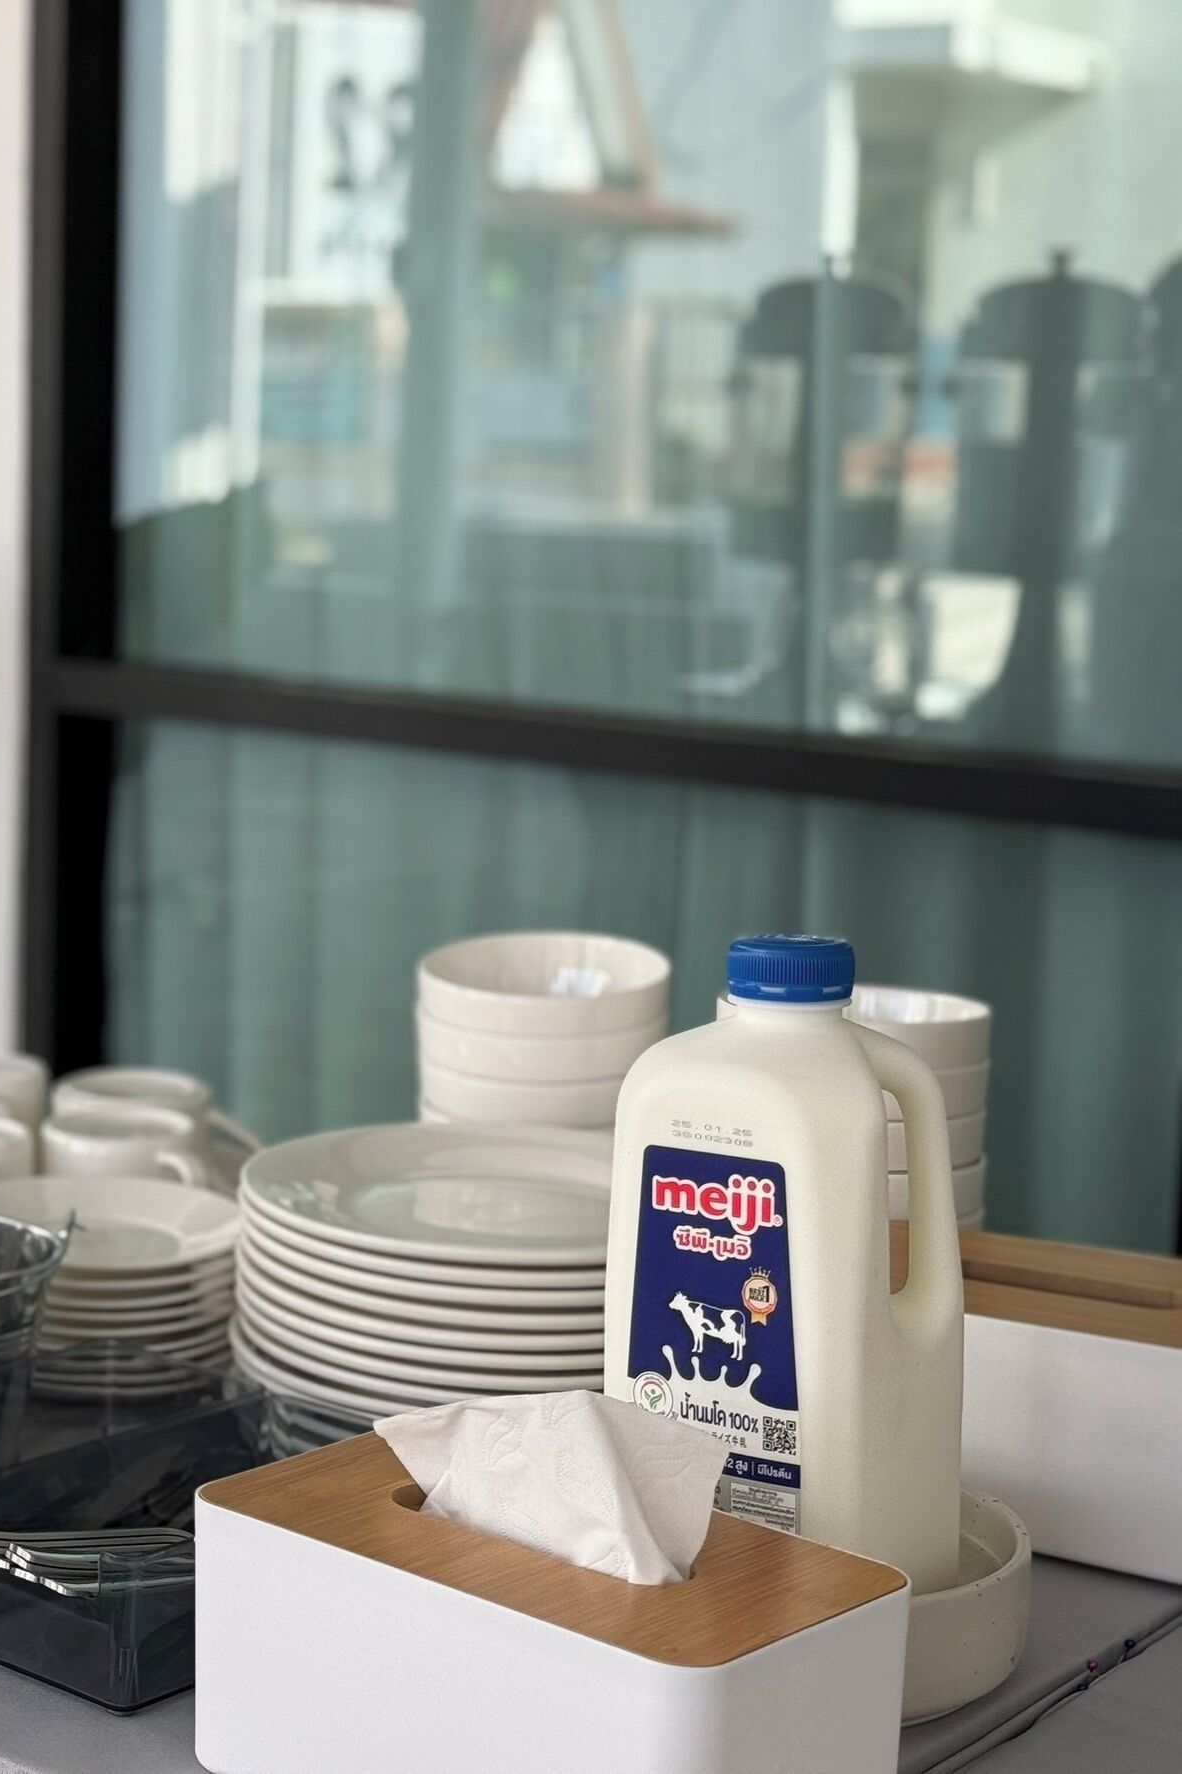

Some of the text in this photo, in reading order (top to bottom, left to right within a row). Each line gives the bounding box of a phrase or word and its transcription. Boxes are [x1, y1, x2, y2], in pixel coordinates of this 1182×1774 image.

[654, 1177, 772, 1233] meiji
[680, 1391, 727, 1428] น้ำนมโค
[729, 1412, 759, 1434] 100%
[735, 1460, 748, 1475] สูง
[757, 1463, 792, 1480] มีโปรตีน
